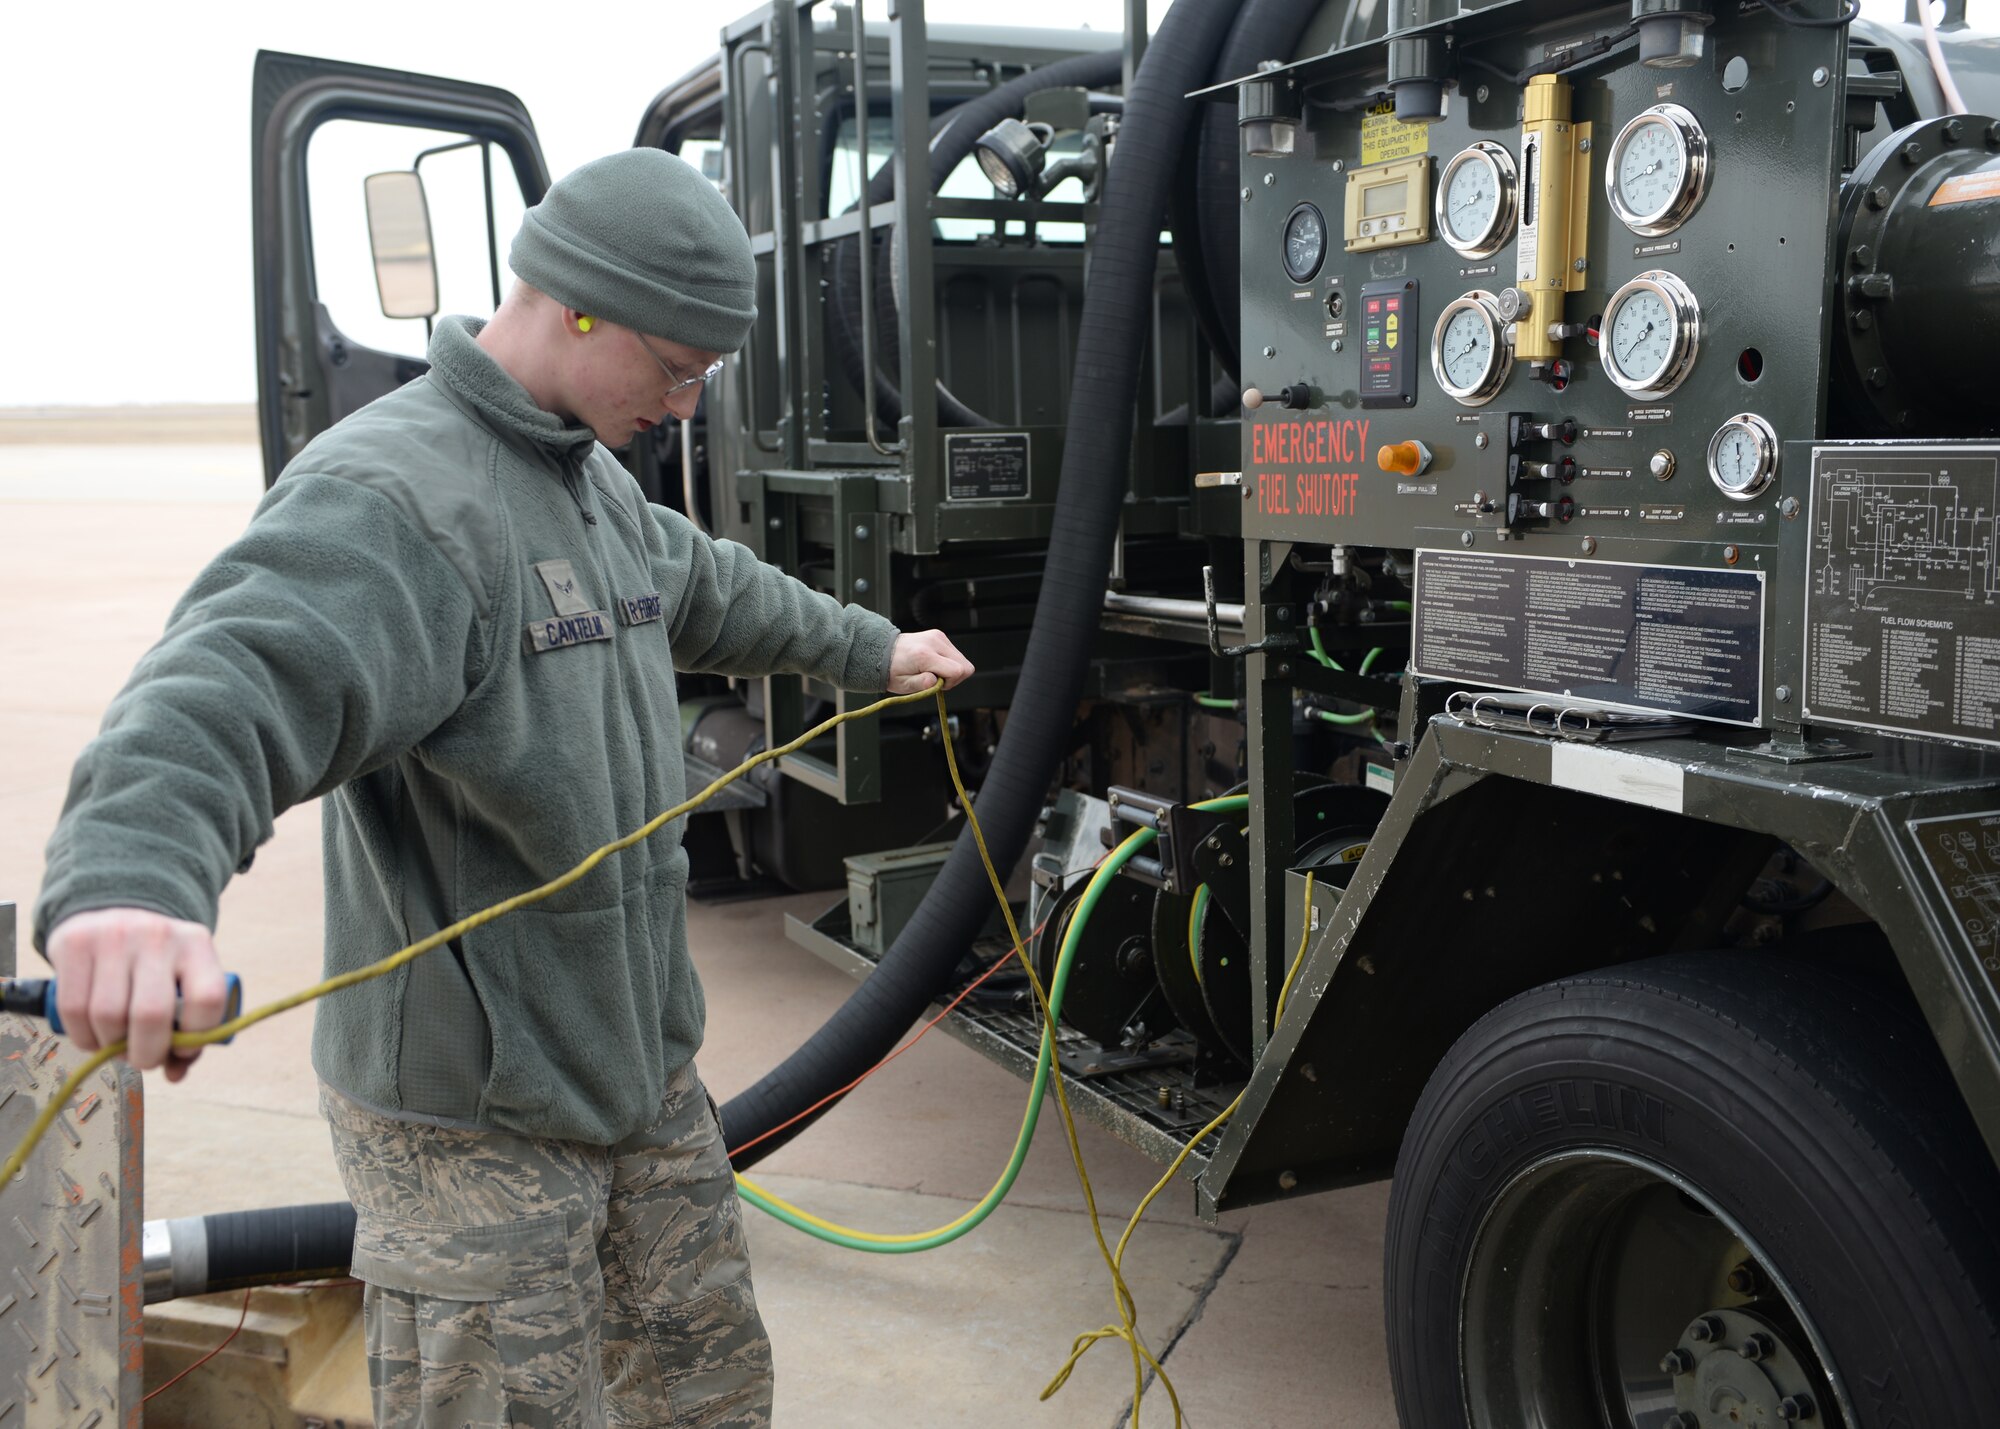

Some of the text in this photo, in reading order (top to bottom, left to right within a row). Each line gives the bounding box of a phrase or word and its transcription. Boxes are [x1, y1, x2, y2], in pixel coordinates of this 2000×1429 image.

[1364, 129, 1378, 139] MUST
[1381, 126, 1388, 136] BE
[1392, 123, 1407, 133] WORN
[1364, 141, 1375, 150] THIS
[1378, 134, 1410, 148] EQUIPMENT
[1380, 146, 1410, 159] OPERATION
[1253, 419, 1370, 464] EMERGENCY
[1258, 474, 1359, 516] FUEL SHUTOFF
[1881, 616, 1953, 630] FUEL FLOW SCHEMATIC
[1421, 1079, 1666, 1264] MICHELIN
